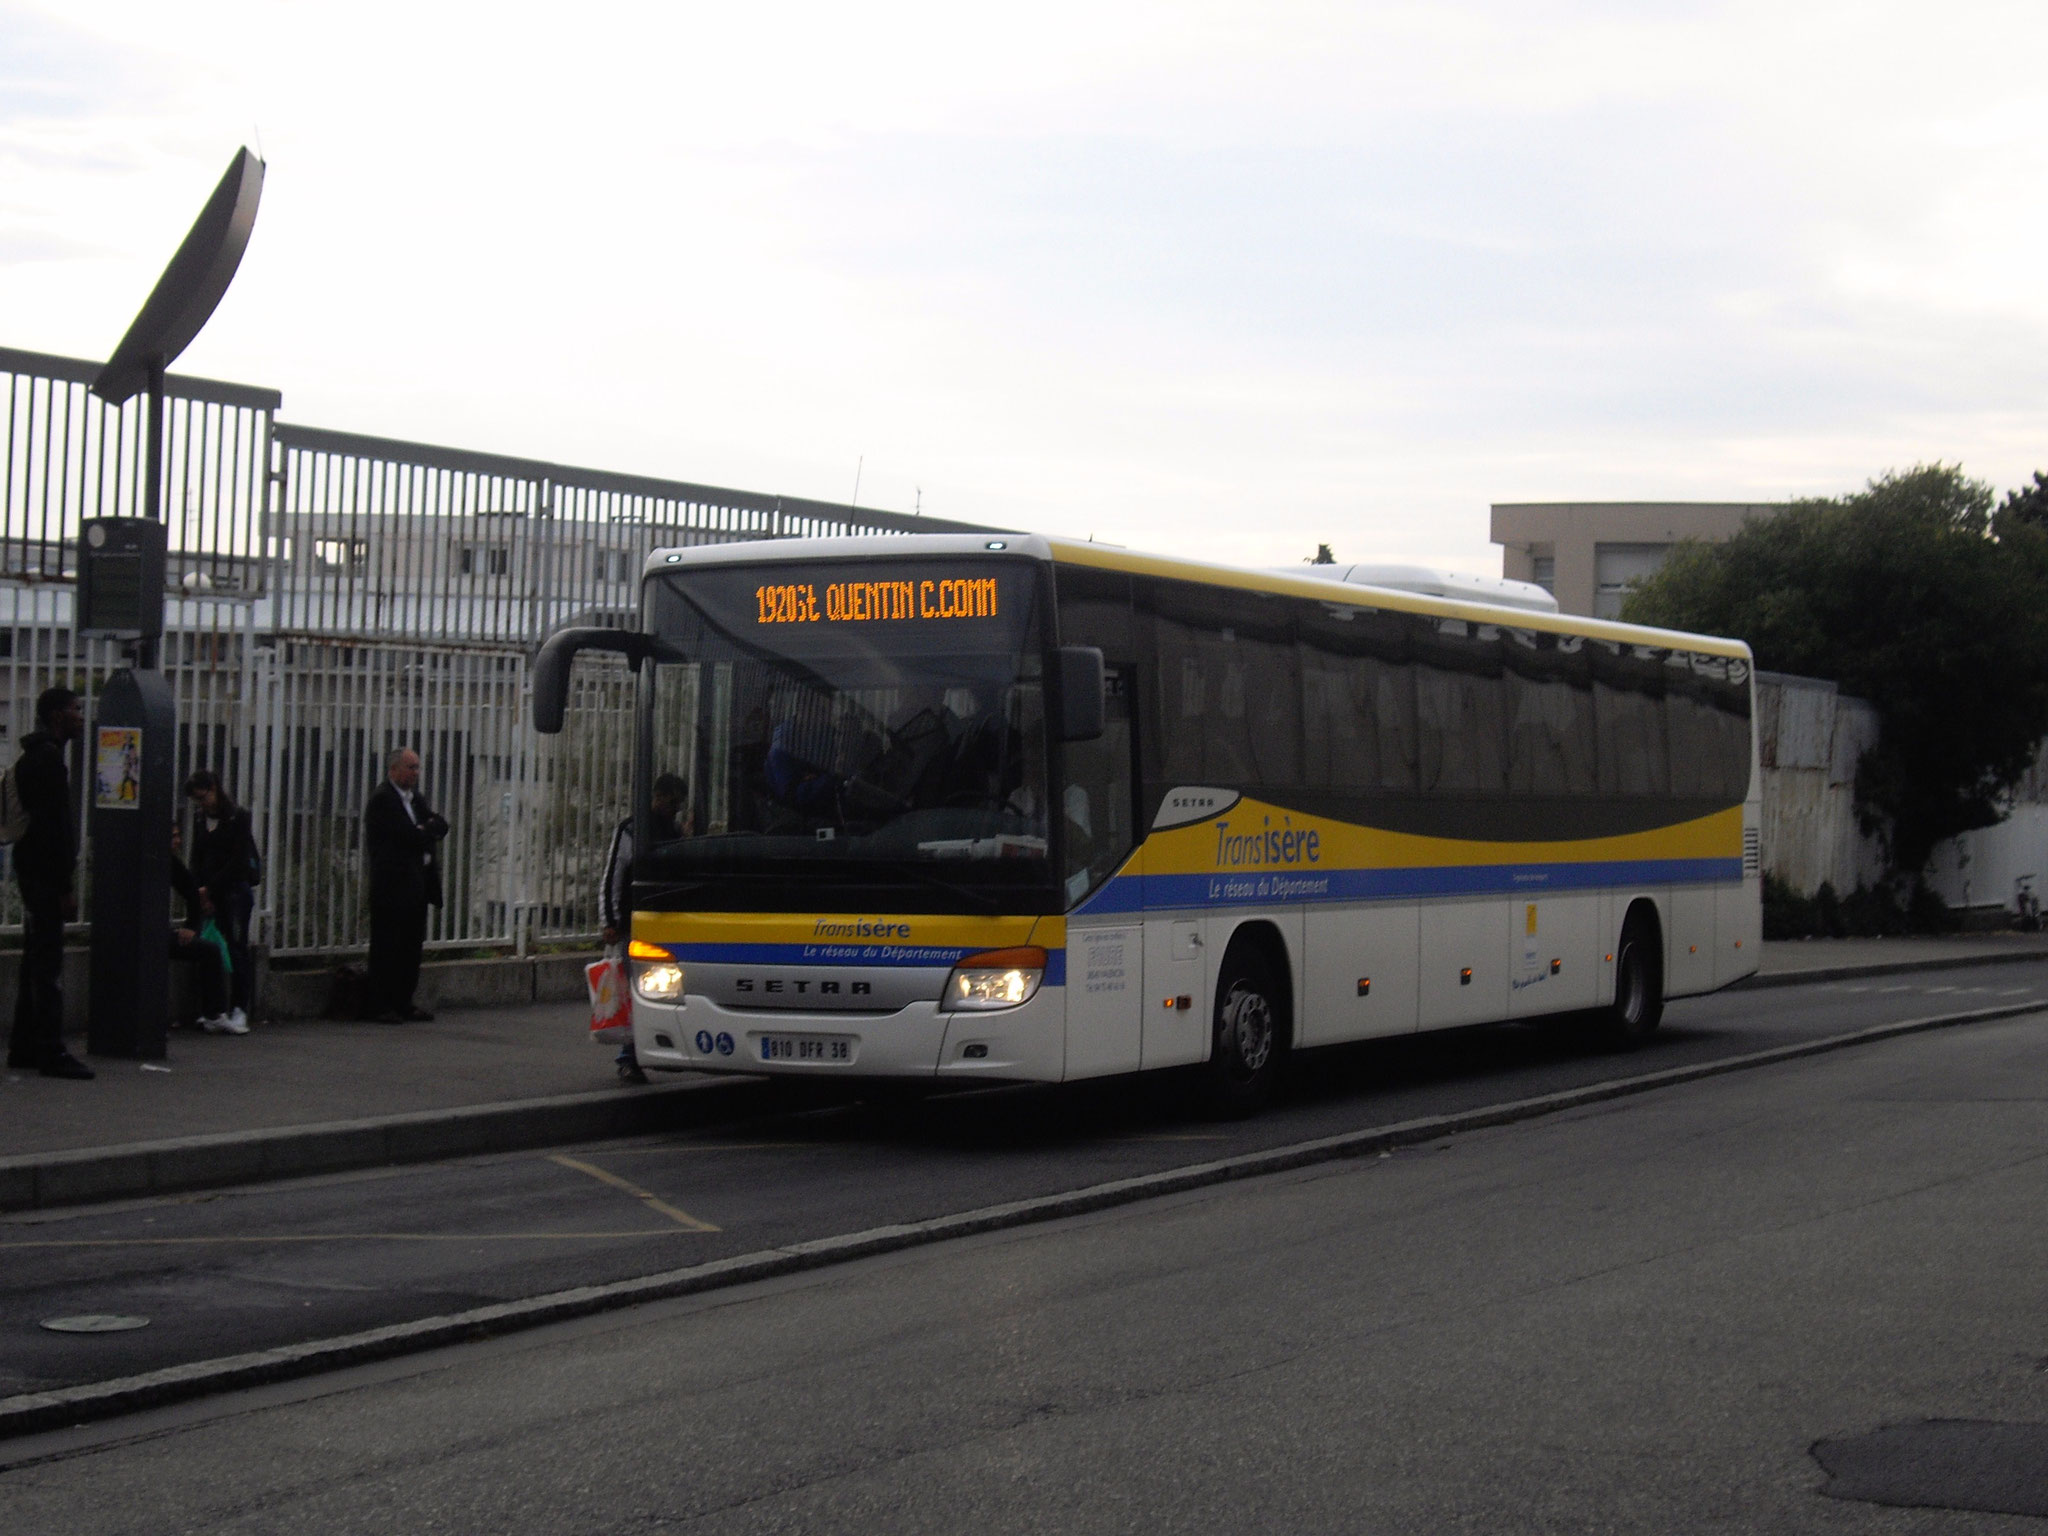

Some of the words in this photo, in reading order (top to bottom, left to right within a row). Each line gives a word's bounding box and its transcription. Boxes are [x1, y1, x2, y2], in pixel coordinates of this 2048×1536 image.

[826, 580, 914, 621] QUENTIN
[919, 578, 997, 619] C.COMM
[1173, 798, 1213, 808] SETRA
[1216, 815, 1320, 866] Transisère
[1209, 879, 1221, 898] Le
[1223, 879, 1255, 898] réseau
[1258, 877, 1269, 897] du
[1271, 876, 1328, 900] Département
[813, 917, 911, 938] Transisère
[803, 945, 816, 957] Le
[821, 945, 857, 958] réseau
[863, 945, 877, 958] du
[881, 946, 963, 961] Département
[736, 979, 871, 995] SETRA
